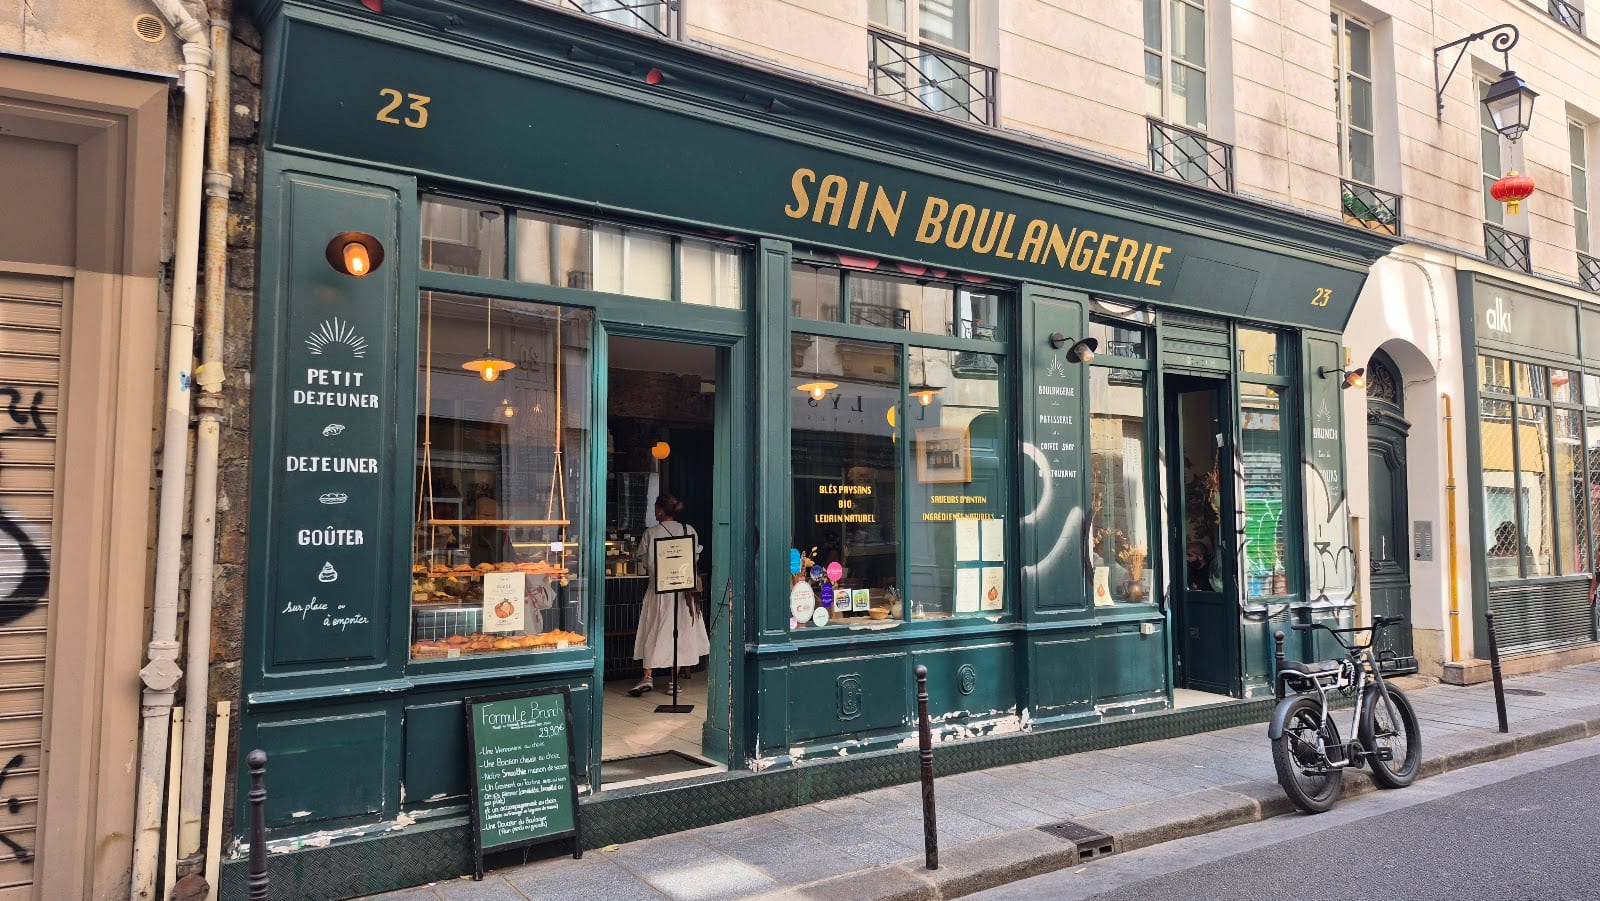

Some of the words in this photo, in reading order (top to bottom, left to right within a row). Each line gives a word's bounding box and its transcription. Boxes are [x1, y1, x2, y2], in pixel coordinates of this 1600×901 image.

[376, 88, 431, 129] 23
[784, 167, 907, 238] SAIN
[915, 196, 1172, 287] BOULANGERIE
[1310, 287, 1333, 307] 23
[307, 368, 364, 387] PETIT
[293, 390, 379, 408] DEJEUNER
[1038, 385, 1075, 396] BOULANGERIE
[1039, 414, 1073, 424] PATISSERIE
[1313, 427, 1338, 440] BRUNCH
[286, 456, 378, 473] DEJEUNER
[819, 485, 838, 494] BLÉS
[839, 485, 872, 495] PAYSANS
[838, 500, 852, 509] BIO
[930, 495, 957, 504] SAVEURS
[958, 495, 987, 504] D'ANTAN
[815, 513, 843, 523] LEVAIN
[844, 514, 876, 523] NATUREL
[298, 526, 364, 546] GOÛTER
[282, 601, 303, 613] sur
[302, 596, 328, 620] place
[323, 614, 331, 626] à
[332, 613, 369, 632] emporter
[538, 723, 565, 738] 29,90€
